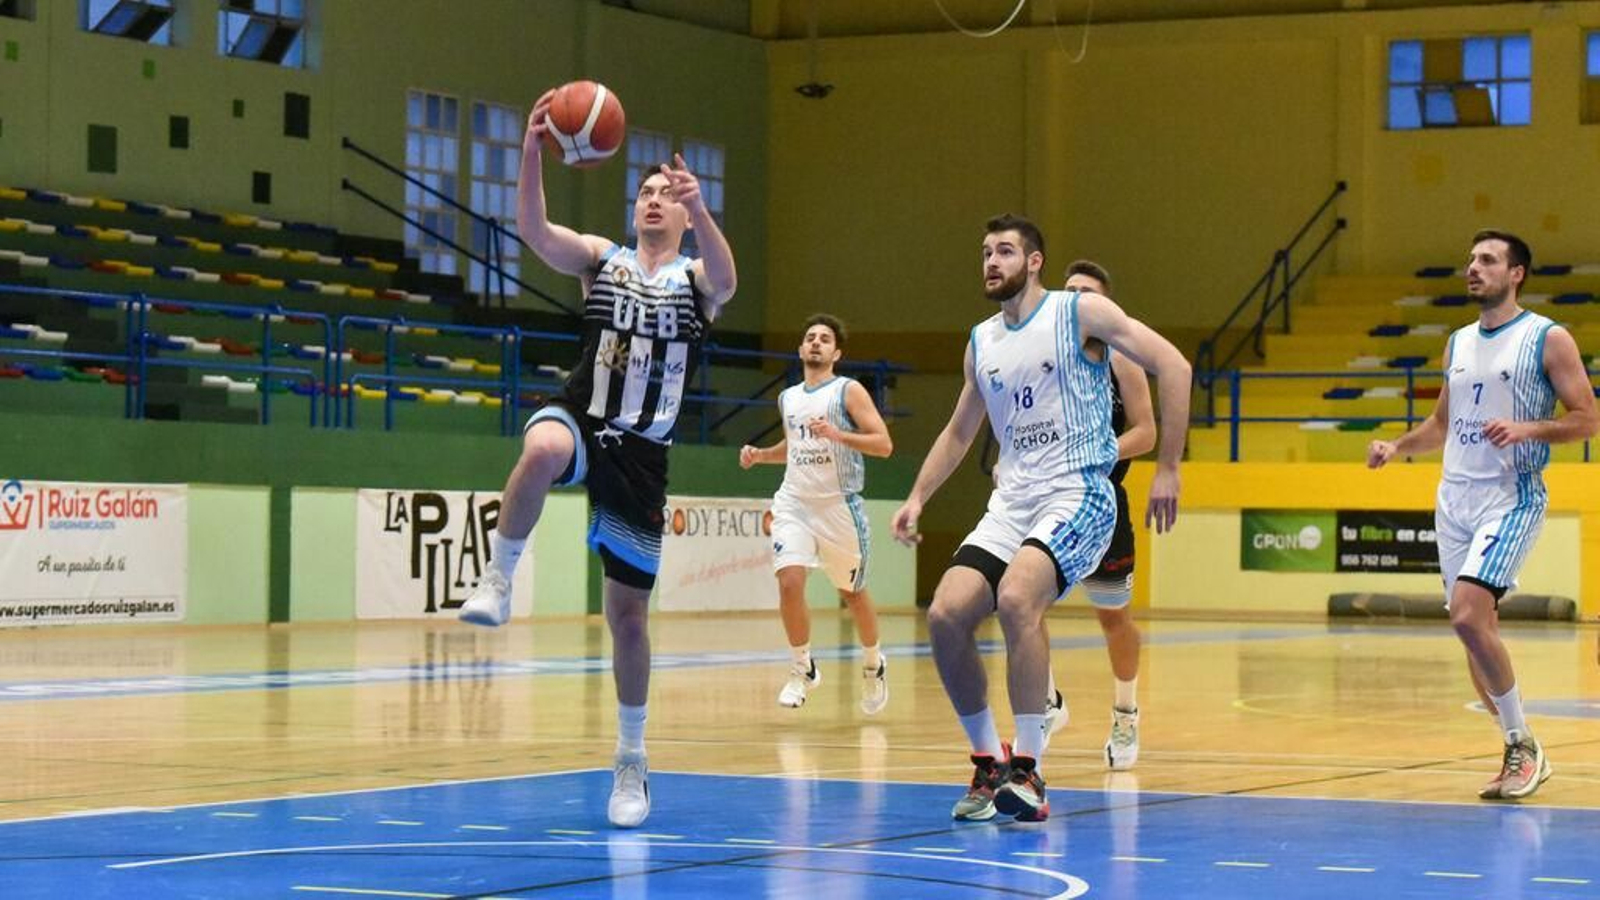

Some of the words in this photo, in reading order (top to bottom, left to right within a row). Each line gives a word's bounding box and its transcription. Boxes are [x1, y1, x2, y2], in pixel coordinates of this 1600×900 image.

[613, 294, 679, 339] ULB
[1014, 386, 1034, 412] 18
[1473, 383, 1483, 405] 7
[1015, 417, 1055, 435] Hospital
[1013, 431, 1060, 450] OCHOA
[1460, 432, 1487, 445] OCH
[48, 488, 91, 518] Ruiz
[95, 488, 158, 519] Galán
[384, 492, 410, 533] LA
[662, 508, 713, 537] BODY
[717, 508, 774, 537] FACTO
[1341, 525, 1357, 541] tu
[1360, 525, 1393, 541] fibra
[1396, 528, 1415, 542] en
[1417, 528, 1437, 542] ca
[1480, 534, 1500, 556] 7
